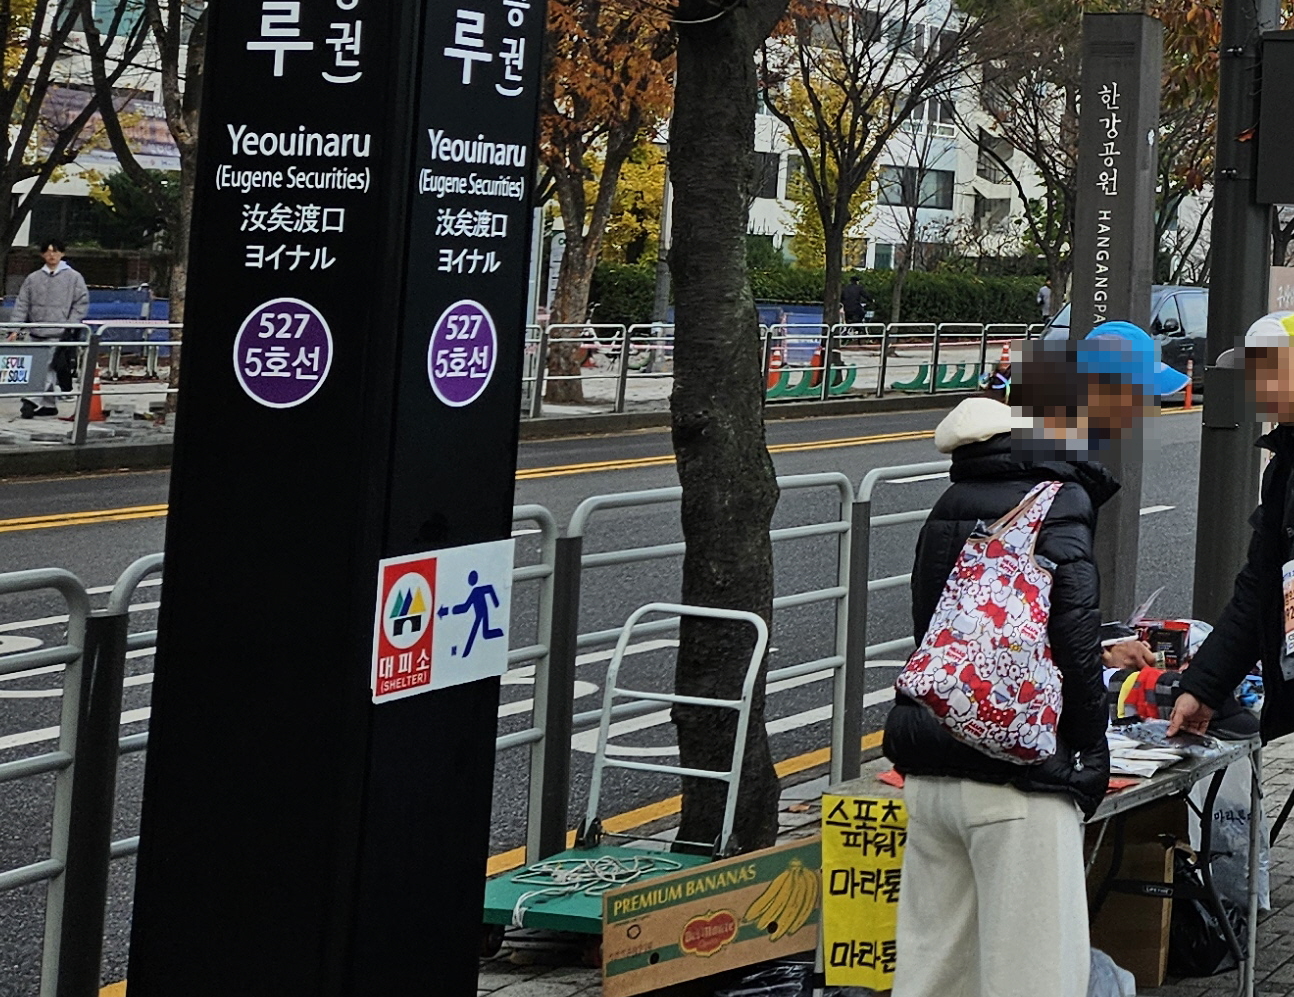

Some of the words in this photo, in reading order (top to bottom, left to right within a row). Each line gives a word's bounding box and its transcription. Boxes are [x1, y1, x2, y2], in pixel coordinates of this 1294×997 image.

[226, 124, 371, 157] Yeouinaru
[428, 129, 527, 168] Yeouinaru
[1096, 81, 1121, 197] 한강공원
[215, 164, 283, 192] (Eugene
[286, 165, 371, 194] Securities)
[418, 168, 467, 196] (Eugene
[468, 172, 525, 201] Securities)
[239, 202, 345, 233] 汝矣渡口
[434, 208, 508, 238] 汝矣渡口
[244, 244, 337, 272] ヨイナル
[436, 249, 502, 274] ヨイナル
[1093, 209, 1112, 326] HANGANGPA
[257, 312, 311, 339] 527
[444, 314, 483, 341] 527
[244, 346, 321, 380] 5호선
[434, 345, 489, 380] 5호선
[378, 648, 430, 679] 대피소
[380, 671, 428, 694] (SHELTER)
[826, 799, 907, 831] 스포츠
[613, 883, 683, 917] PREMIUM
[685, 864, 757, 897] BANANAS
